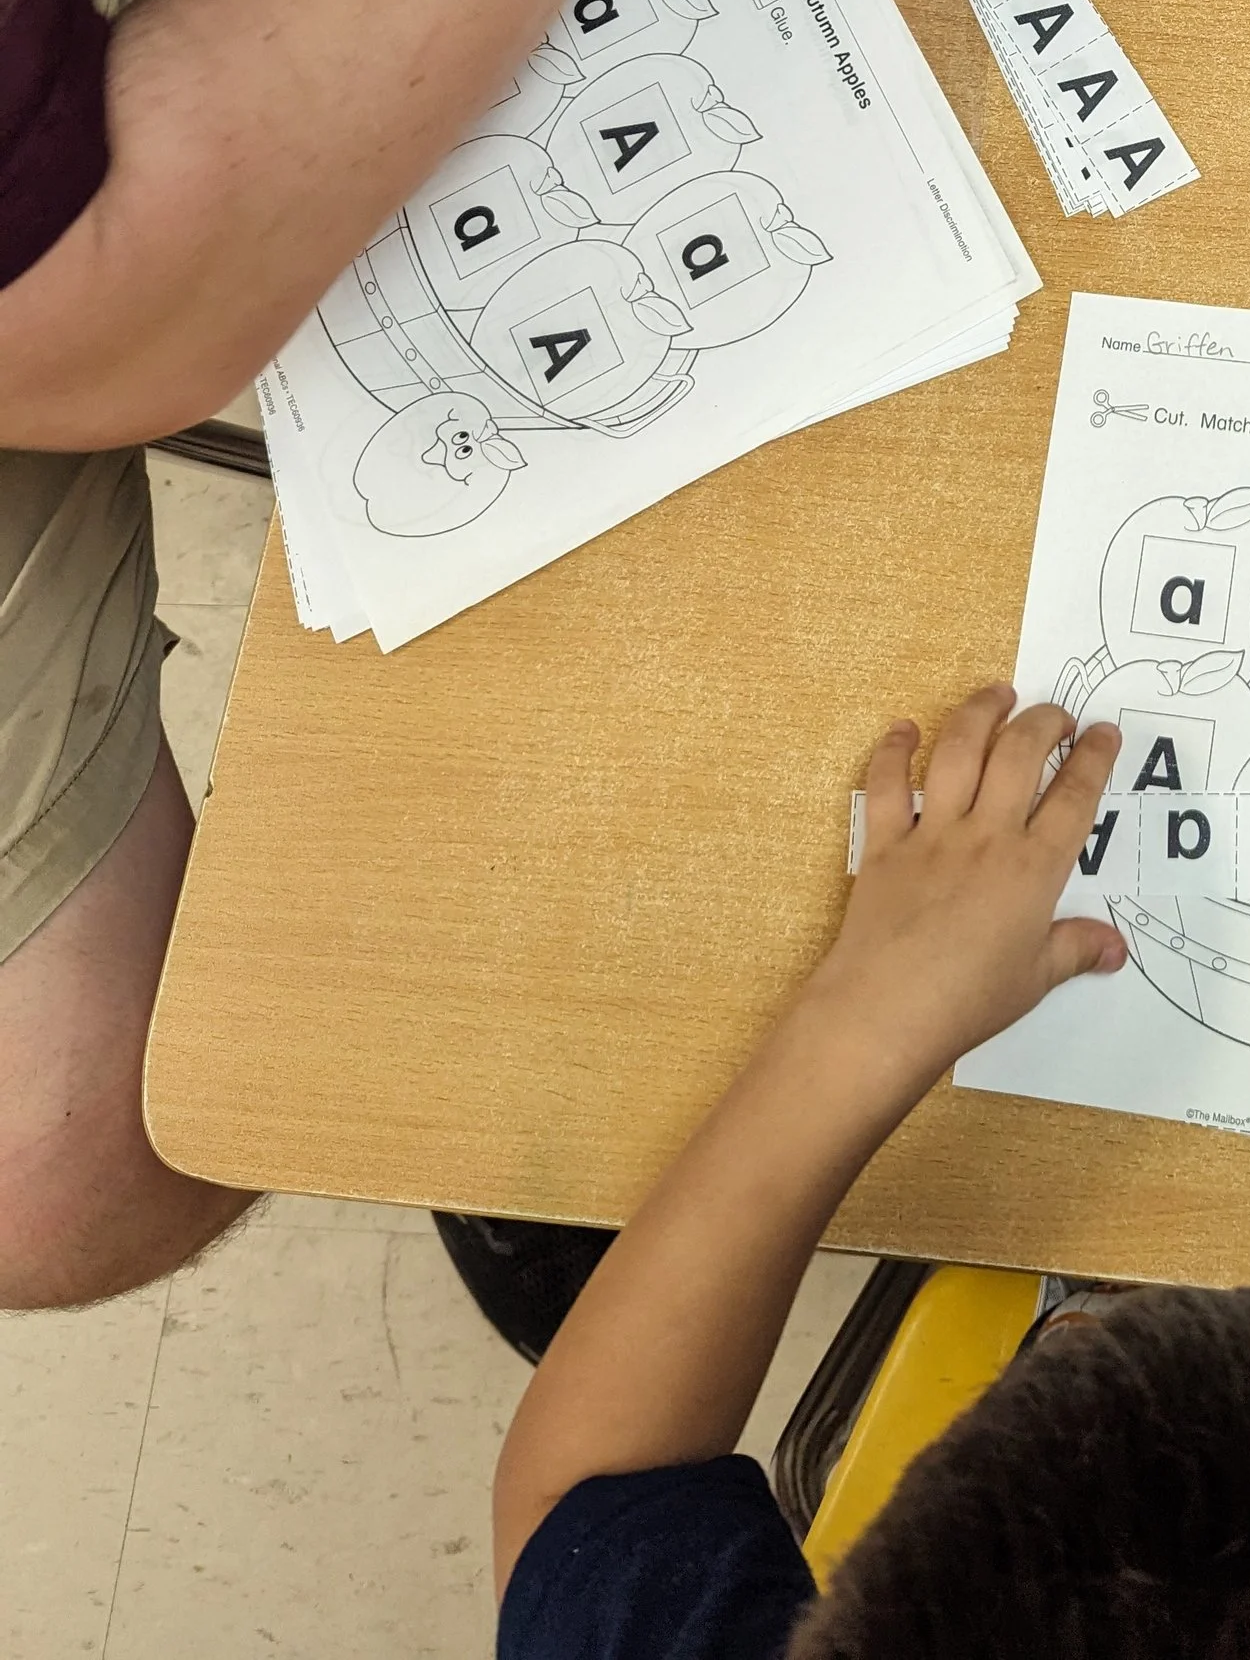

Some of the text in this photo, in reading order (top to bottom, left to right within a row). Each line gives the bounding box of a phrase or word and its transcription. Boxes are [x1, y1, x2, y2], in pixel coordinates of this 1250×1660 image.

[769, 5, 793, 46] Glue.
[834, 51, 872, 110] Apples
[1014, 2, 1074, 56] A
[1057, 69, 1120, 123] A
[1103, 136, 1166, 191] A
[598, 119, 661, 173] A
[453, 204, 500, 252] a
[926, 178, 972, 263] Letter Discrimination
[681, 233, 729, 281] a
[528, 327, 591, 383] A
[1101, 336, 1141, 352] Name
[1146, 330, 1235, 358] Griffen
[1154, 407, 1188, 426] Cut.
[1159, 576, 1205, 625] a
[1131, 736, 1182, 791] A
[1167, 808, 1211, 860] a
